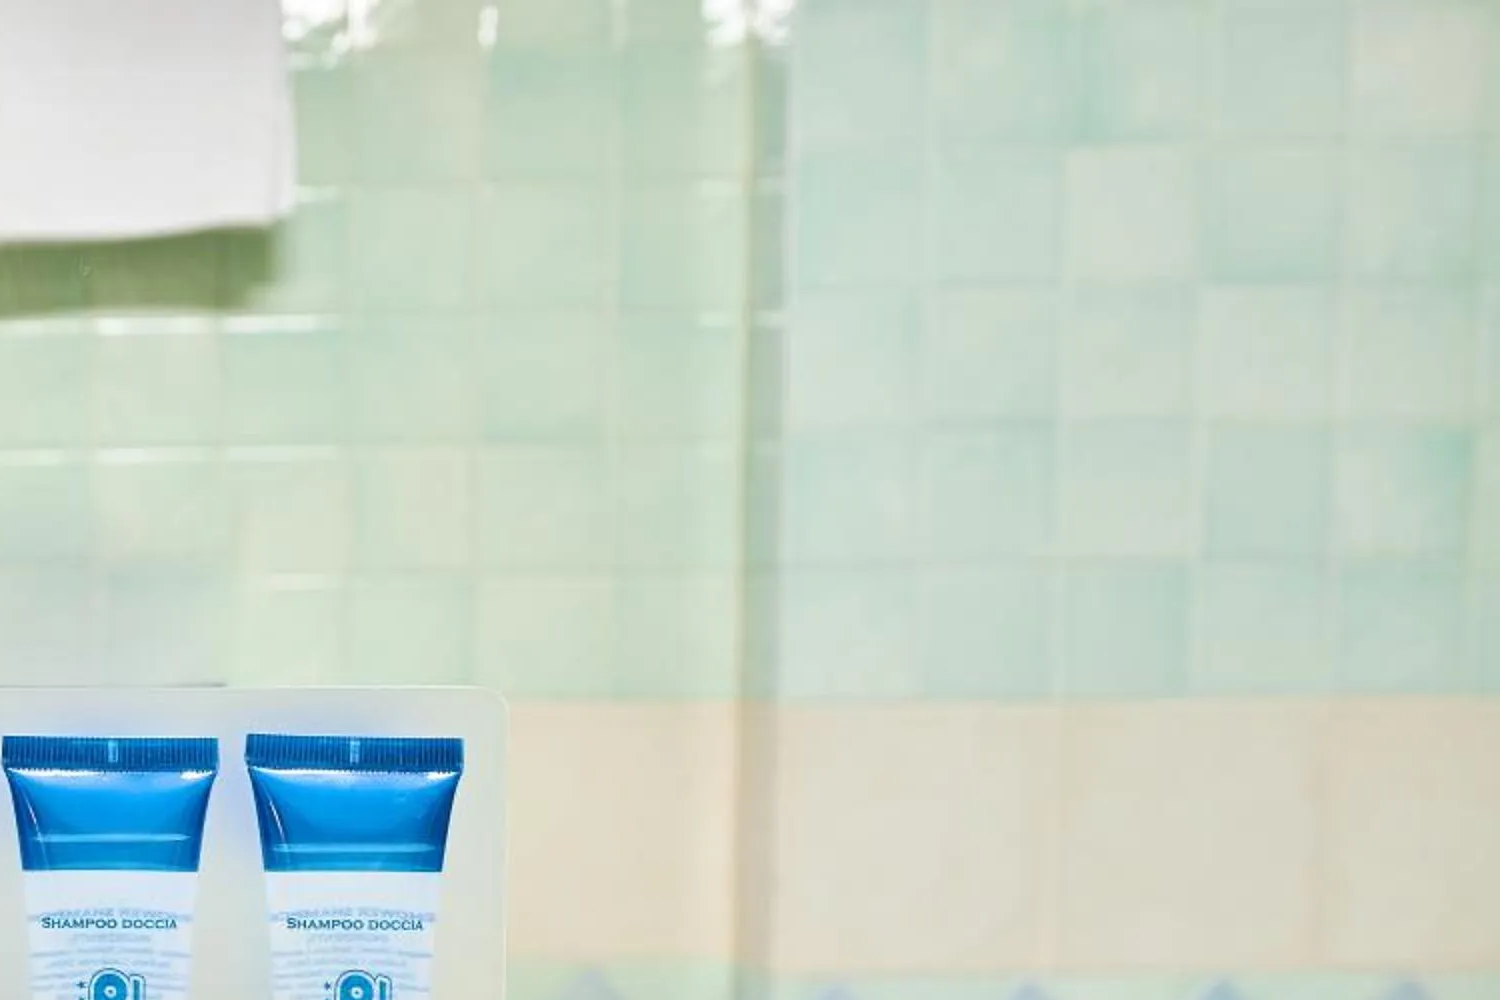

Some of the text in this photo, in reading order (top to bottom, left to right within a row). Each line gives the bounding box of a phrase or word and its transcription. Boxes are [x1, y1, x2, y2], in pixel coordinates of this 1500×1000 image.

[41, 917, 177, 929] SHAMPOO DOCCIA
[287, 917, 423, 931] SHAMPOO DOCCIA
